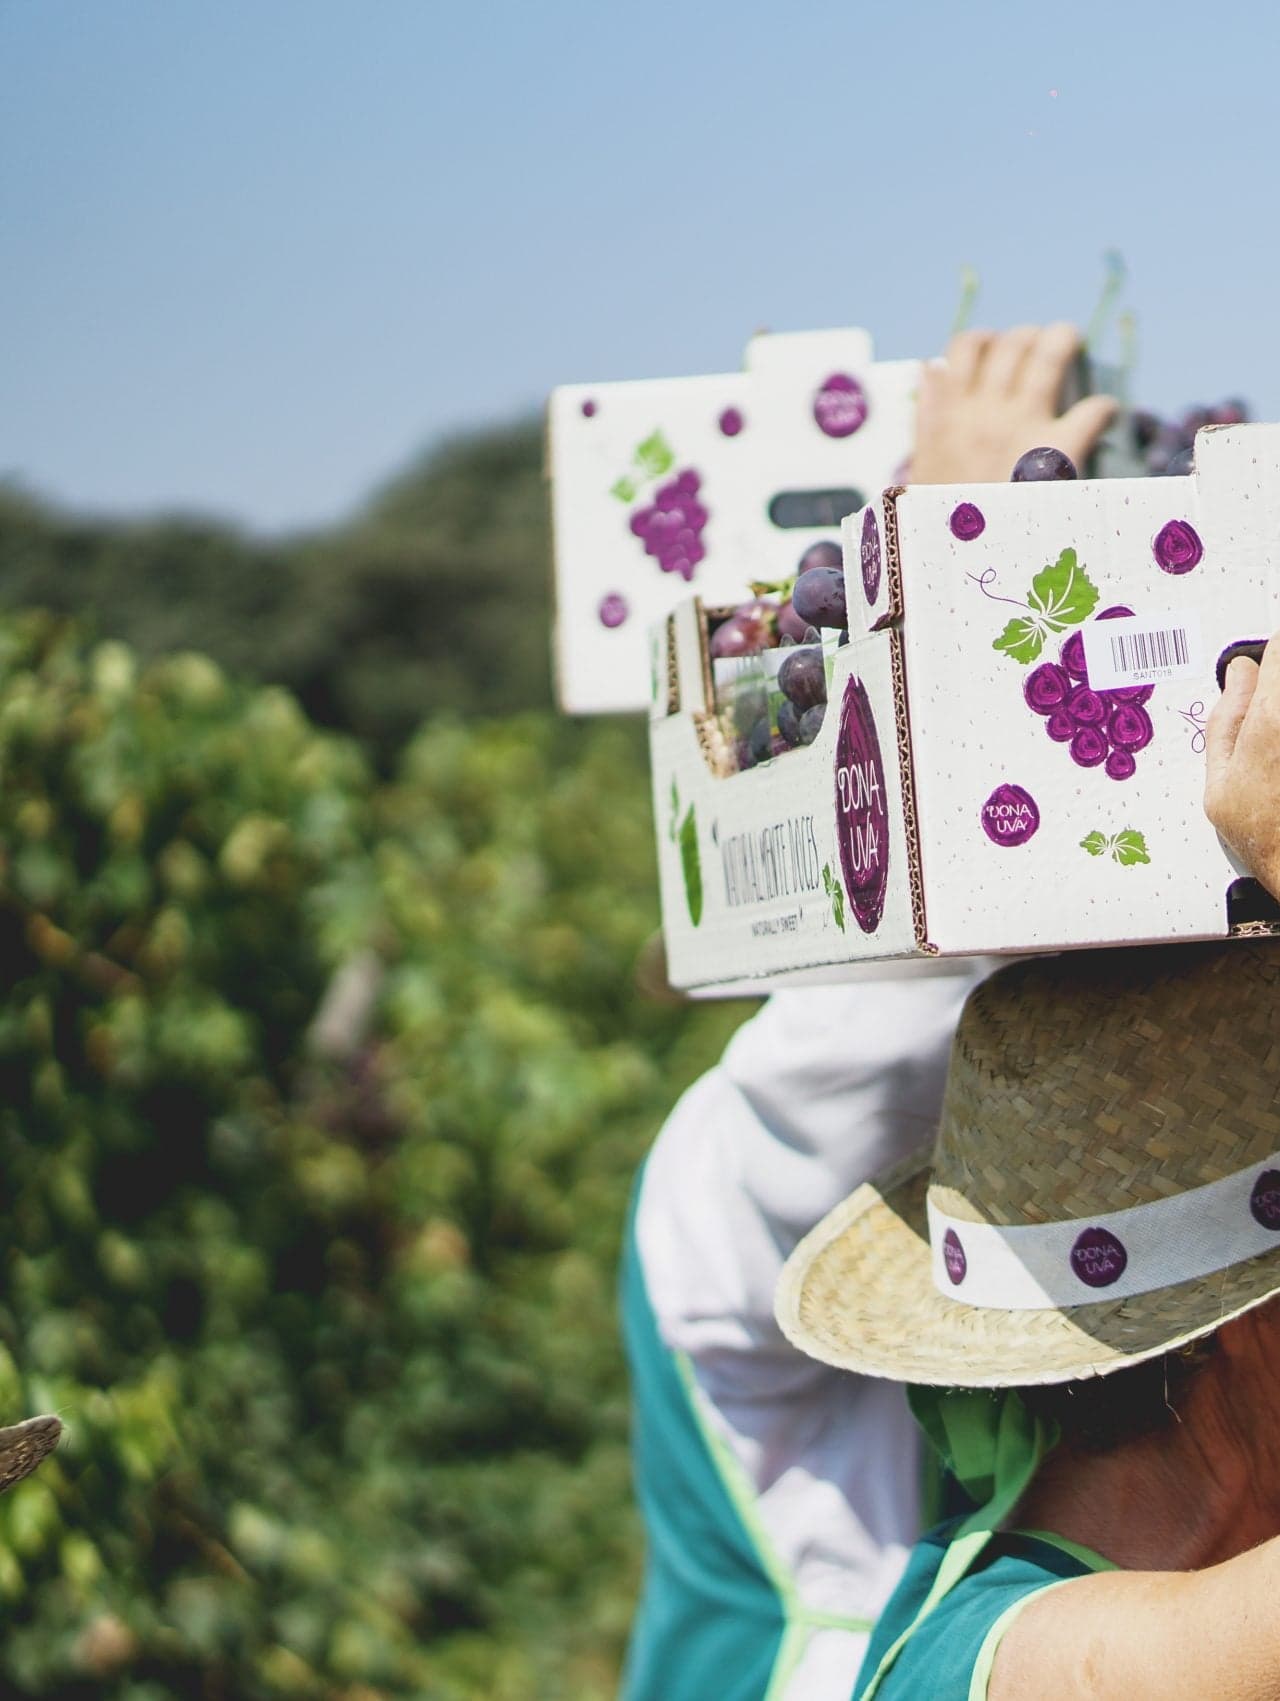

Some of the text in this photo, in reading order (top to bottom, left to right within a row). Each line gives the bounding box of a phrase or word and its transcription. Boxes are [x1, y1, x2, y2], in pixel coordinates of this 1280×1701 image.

[837, 759, 884, 816] DONA
[986, 803, 1034, 819] DONA
[996, 816, 1028, 833] UVA
[850, 811, 880, 872] UVA
[1074, 1244, 1121, 1262] DONA
[1085, 1257, 1115, 1274] UVA
